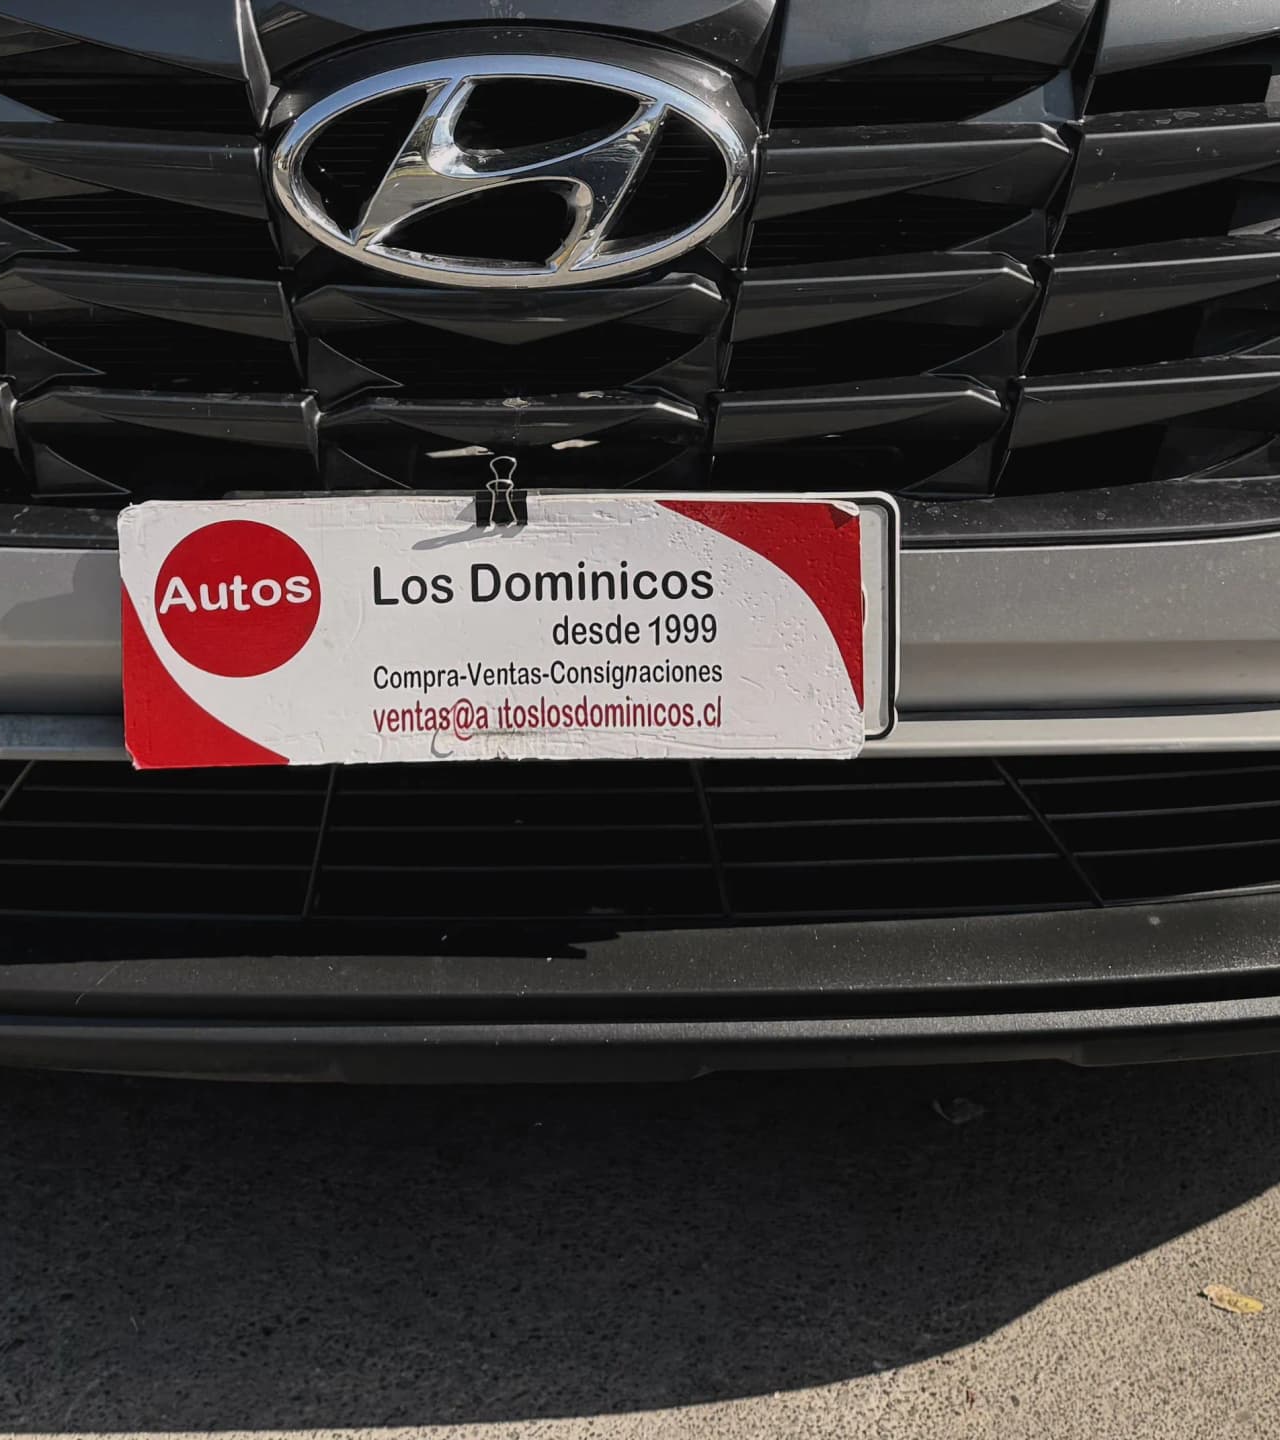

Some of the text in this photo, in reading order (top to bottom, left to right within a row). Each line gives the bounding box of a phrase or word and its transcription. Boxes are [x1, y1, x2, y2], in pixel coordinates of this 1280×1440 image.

[158, 569, 313, 614] Autos
[373, 560, 715, 606] Los Dominicos
[552, 613, 718, 646] desde 1999
[373, 659, 723, 694] Compra-Ventas-Consignaciones
